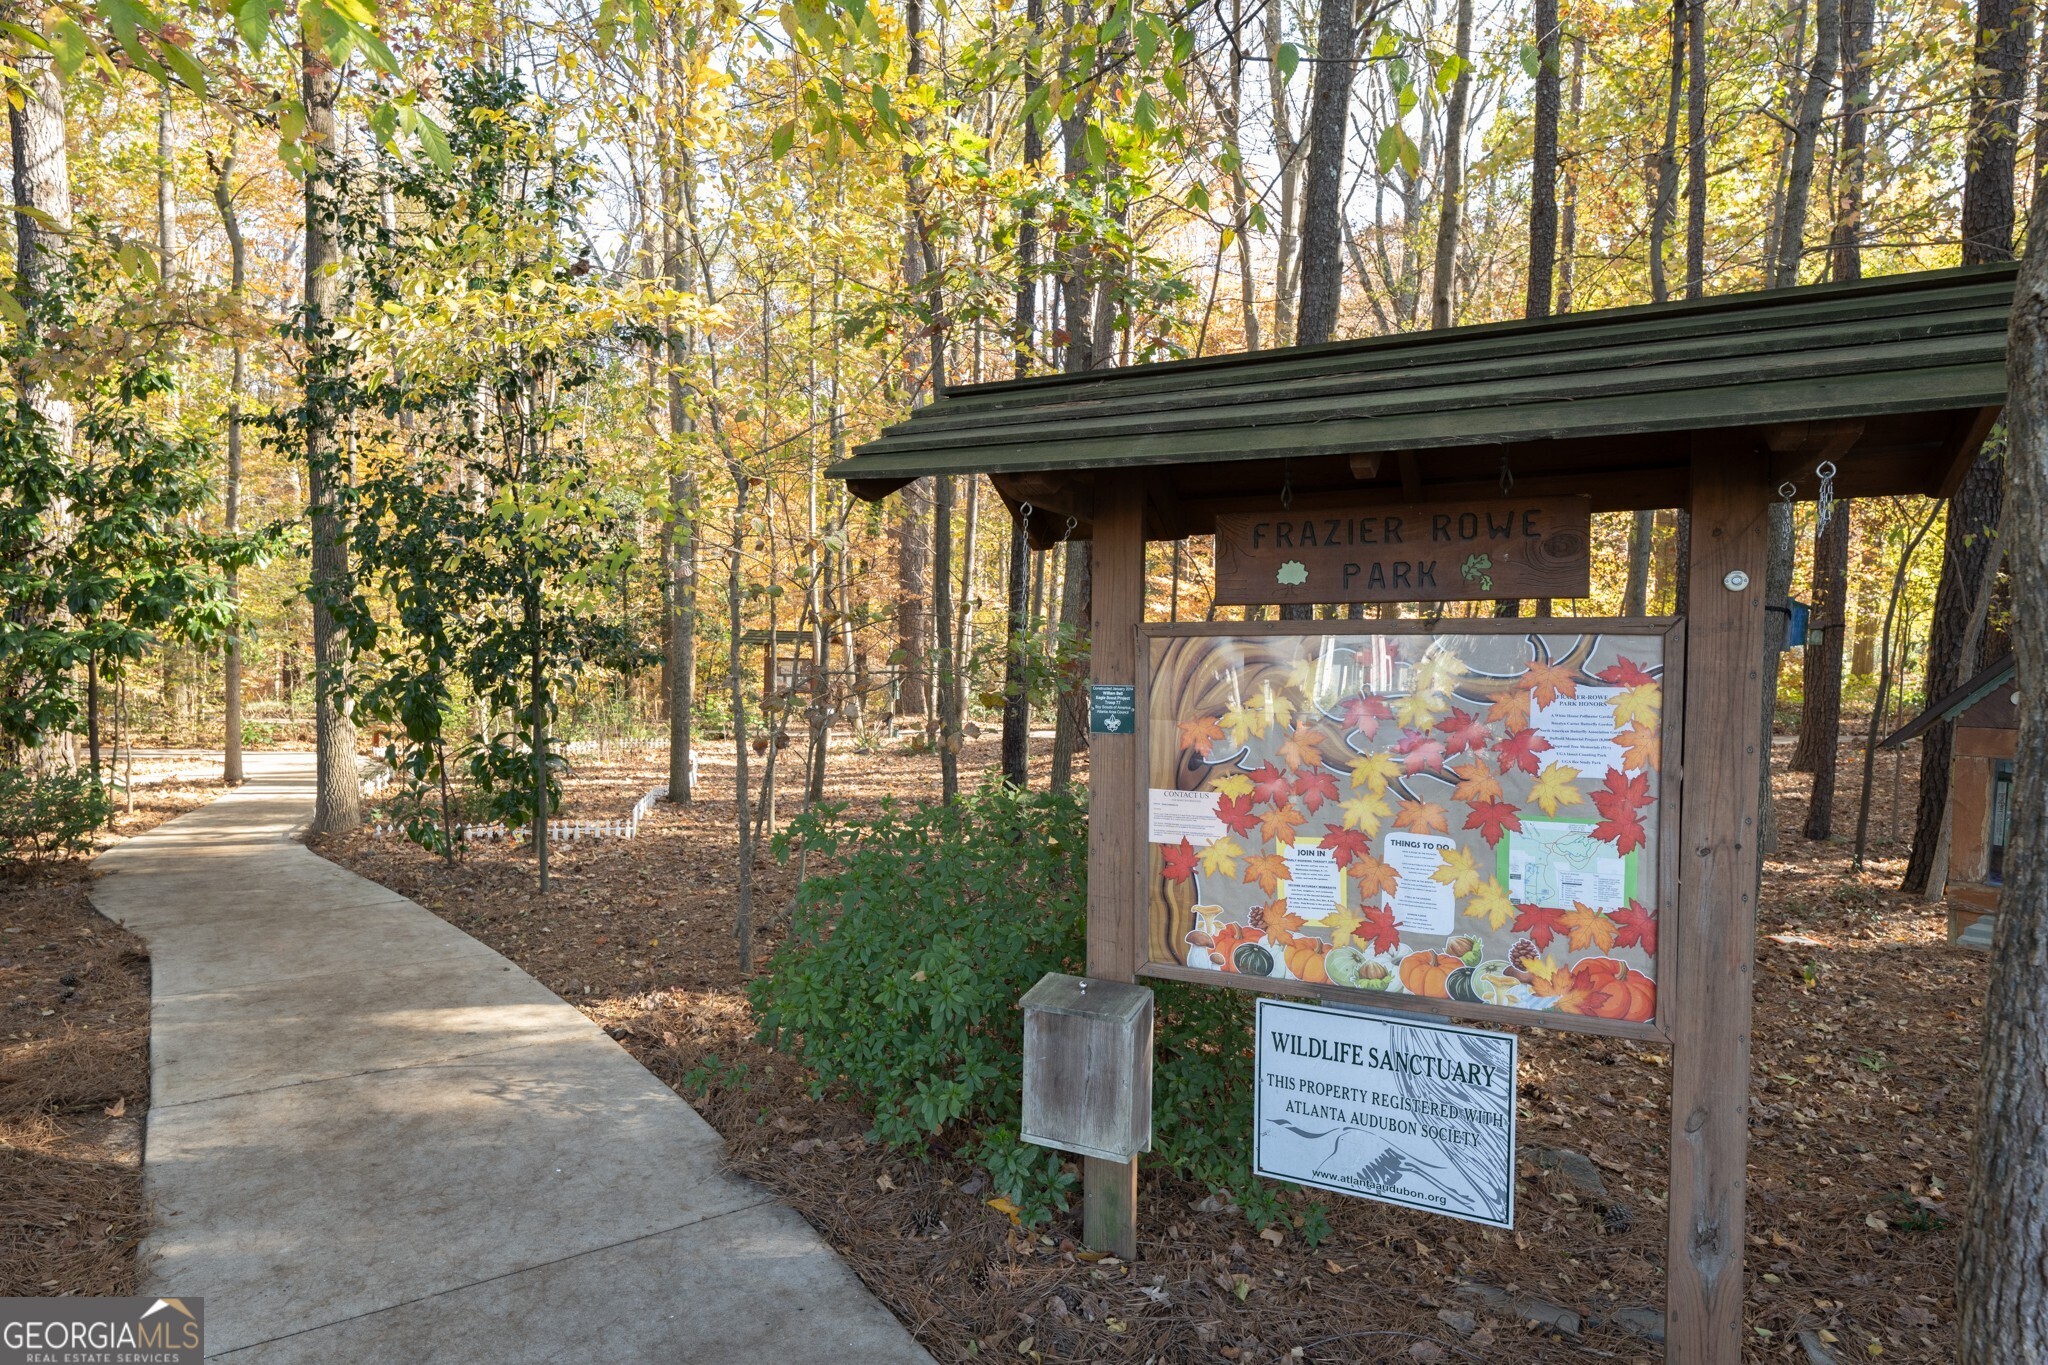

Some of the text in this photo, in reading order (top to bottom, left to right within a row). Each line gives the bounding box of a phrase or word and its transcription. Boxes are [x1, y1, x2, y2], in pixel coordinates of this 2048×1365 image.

[1253, 509, 1542, 549] FRAZIER ROWE
[1343, 560, 1438, 590] PARK
[1390, 840, 1420, 848] THINGS
[1271, 1031, 1497, 1087] WILDLIFE SANCTUARY
[1267, 1072, 1504, 1128] THIS PROPERTY REGISTERED WITH
[1286, 1100, 1480, 1147] ATLANTA AUDUBON SOCIETY
[1311, 1169, 1447, 1206] www.atlantaaudubon.org
